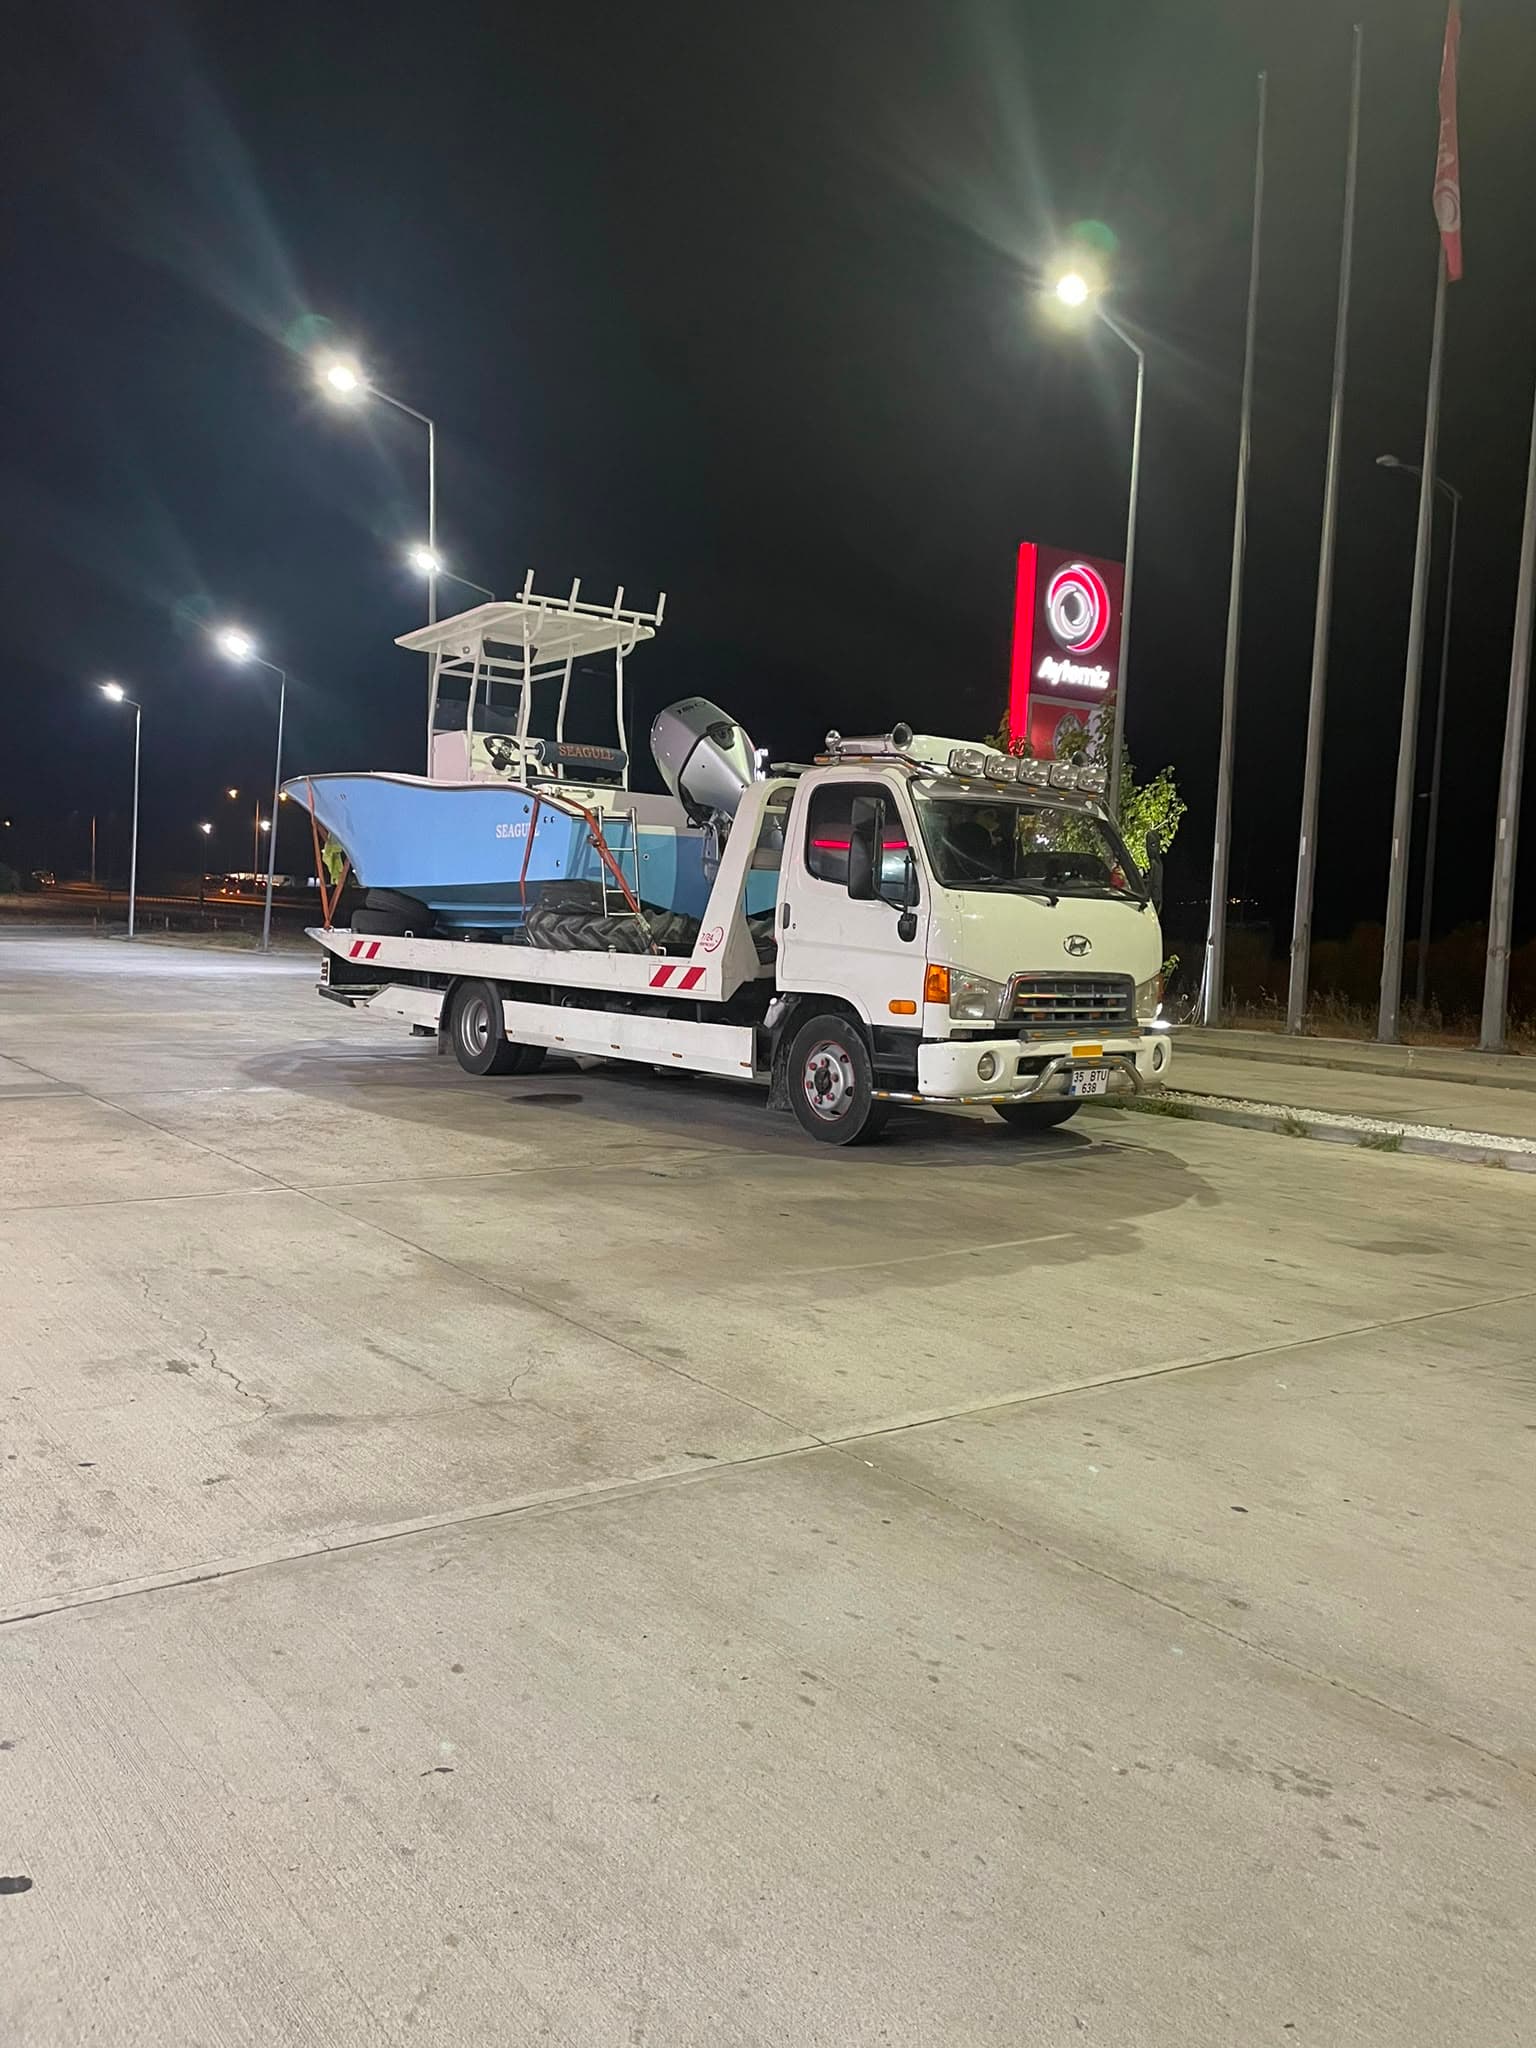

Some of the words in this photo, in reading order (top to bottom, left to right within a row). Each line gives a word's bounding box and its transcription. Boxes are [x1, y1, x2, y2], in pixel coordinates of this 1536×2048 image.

[1037, 655, 1110, 689] Aytemiz
[559, 744, 615, 761] SEAGULL
[495, 822, 540, 839] SEAGUL
[1074, 1071, 1085, 1082] 35
[1090, 1070, 1107, 1082] BTU
[1081, 1082, 1097, 1094] 638
